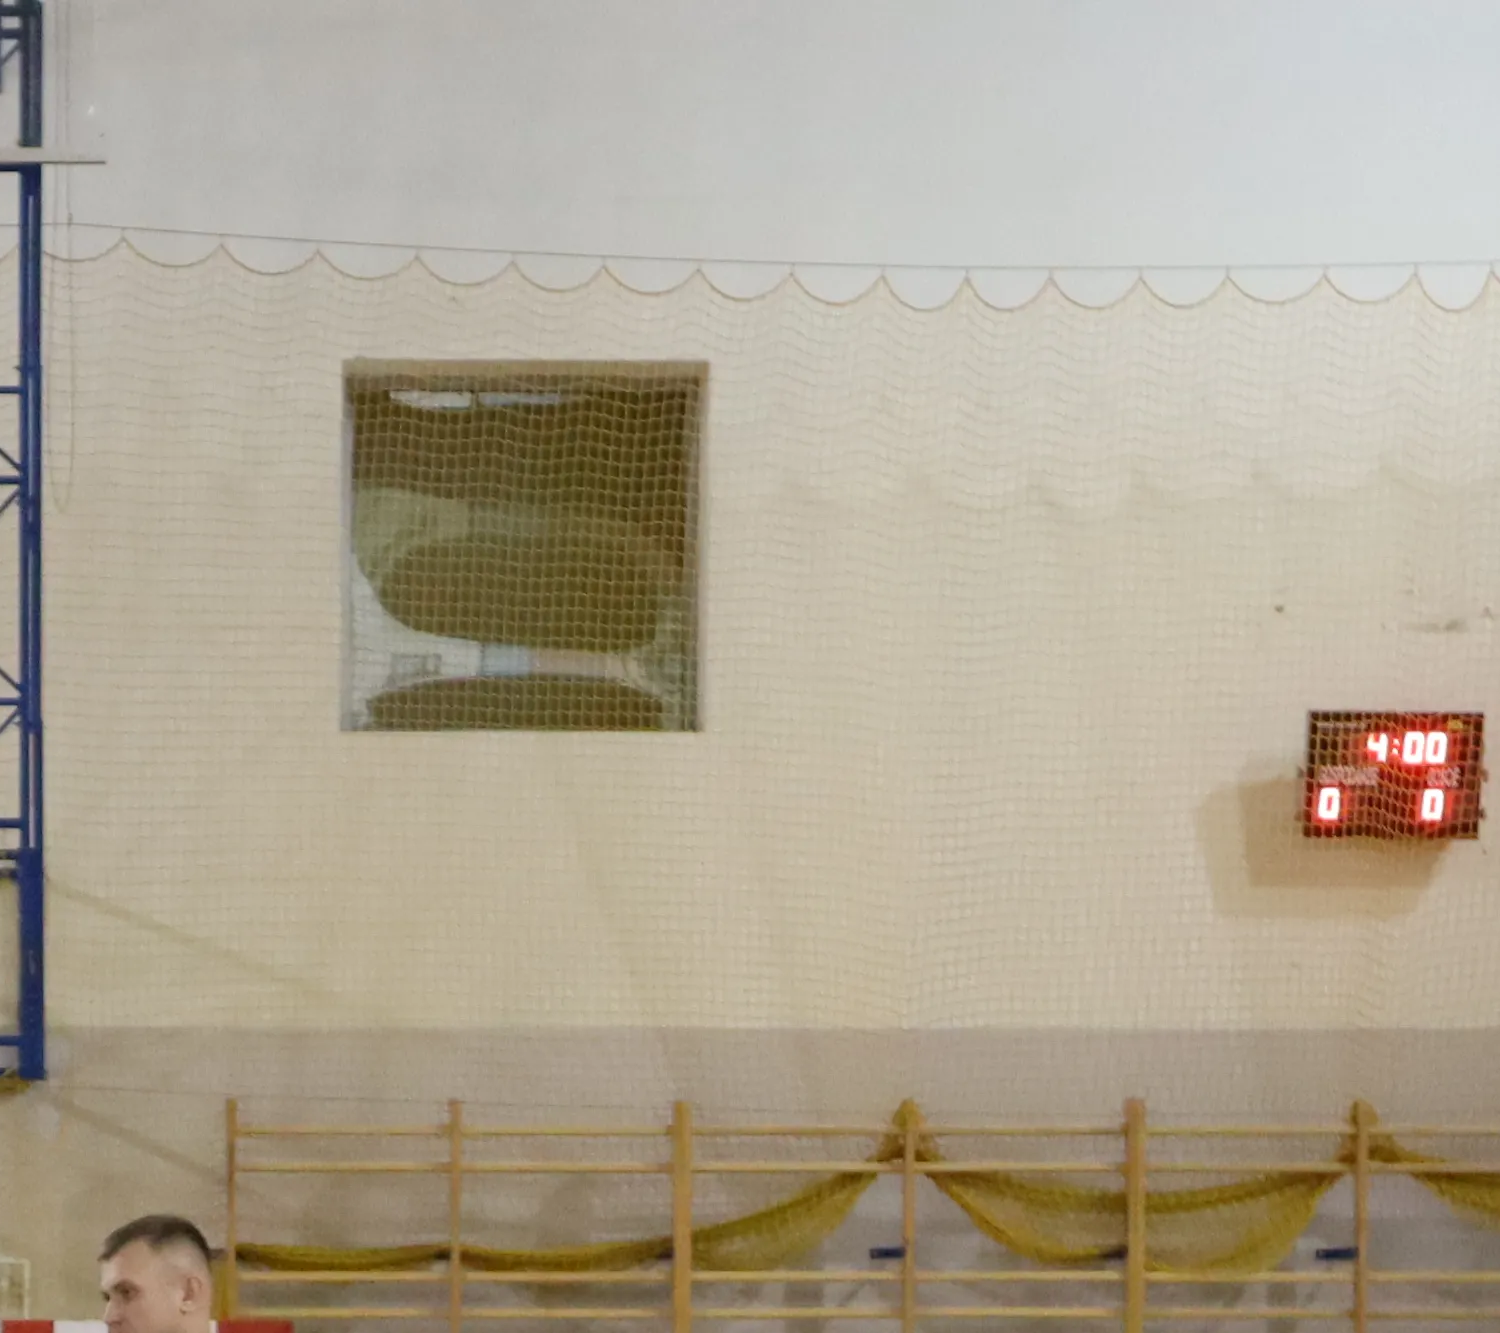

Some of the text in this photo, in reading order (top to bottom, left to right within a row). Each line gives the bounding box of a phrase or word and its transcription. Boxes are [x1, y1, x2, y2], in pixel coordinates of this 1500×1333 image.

[1367, 731, 1448, 764] 4:00
[1317, 787, 1340, 820] 0
[1421, 788, 1444, 821] 0
